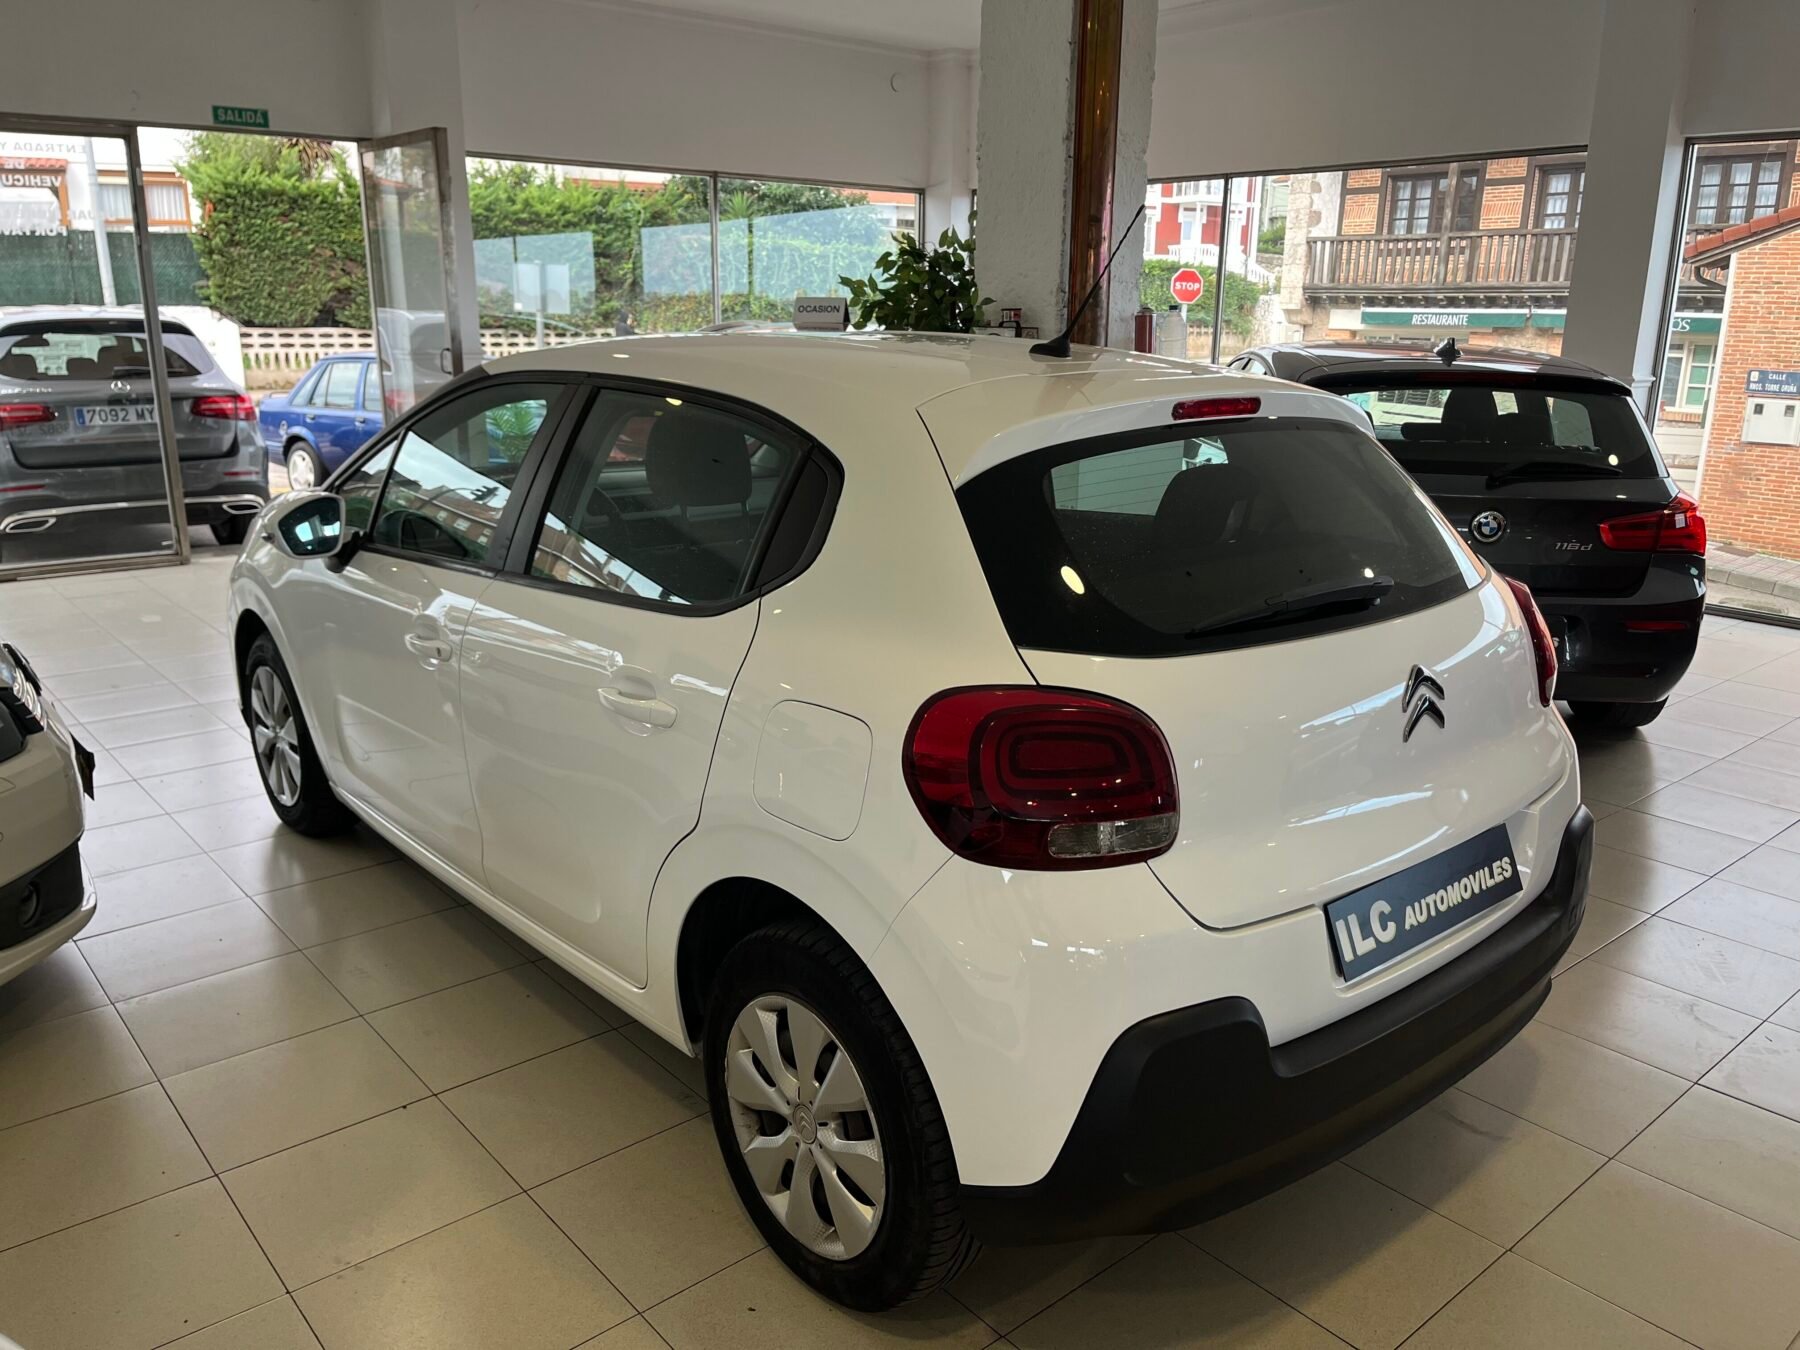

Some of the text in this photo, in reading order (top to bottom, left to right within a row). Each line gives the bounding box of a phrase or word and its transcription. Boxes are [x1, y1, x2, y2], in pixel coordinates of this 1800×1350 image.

[217, 108, 265, 125] SALIDA
[1174, 281, 1200, 291] STOP
[798, 304, 841, 313] OCASION
[1411, 313, 1469, 326] RESTAURANTE
[1768, 373, 1787, 381] CALLE
[86, 408, 130, 423] 7092
[1555, 542, 1593, 551] 116d
[1335, 856, 1513, 963] ILC AUTOMOVILES
